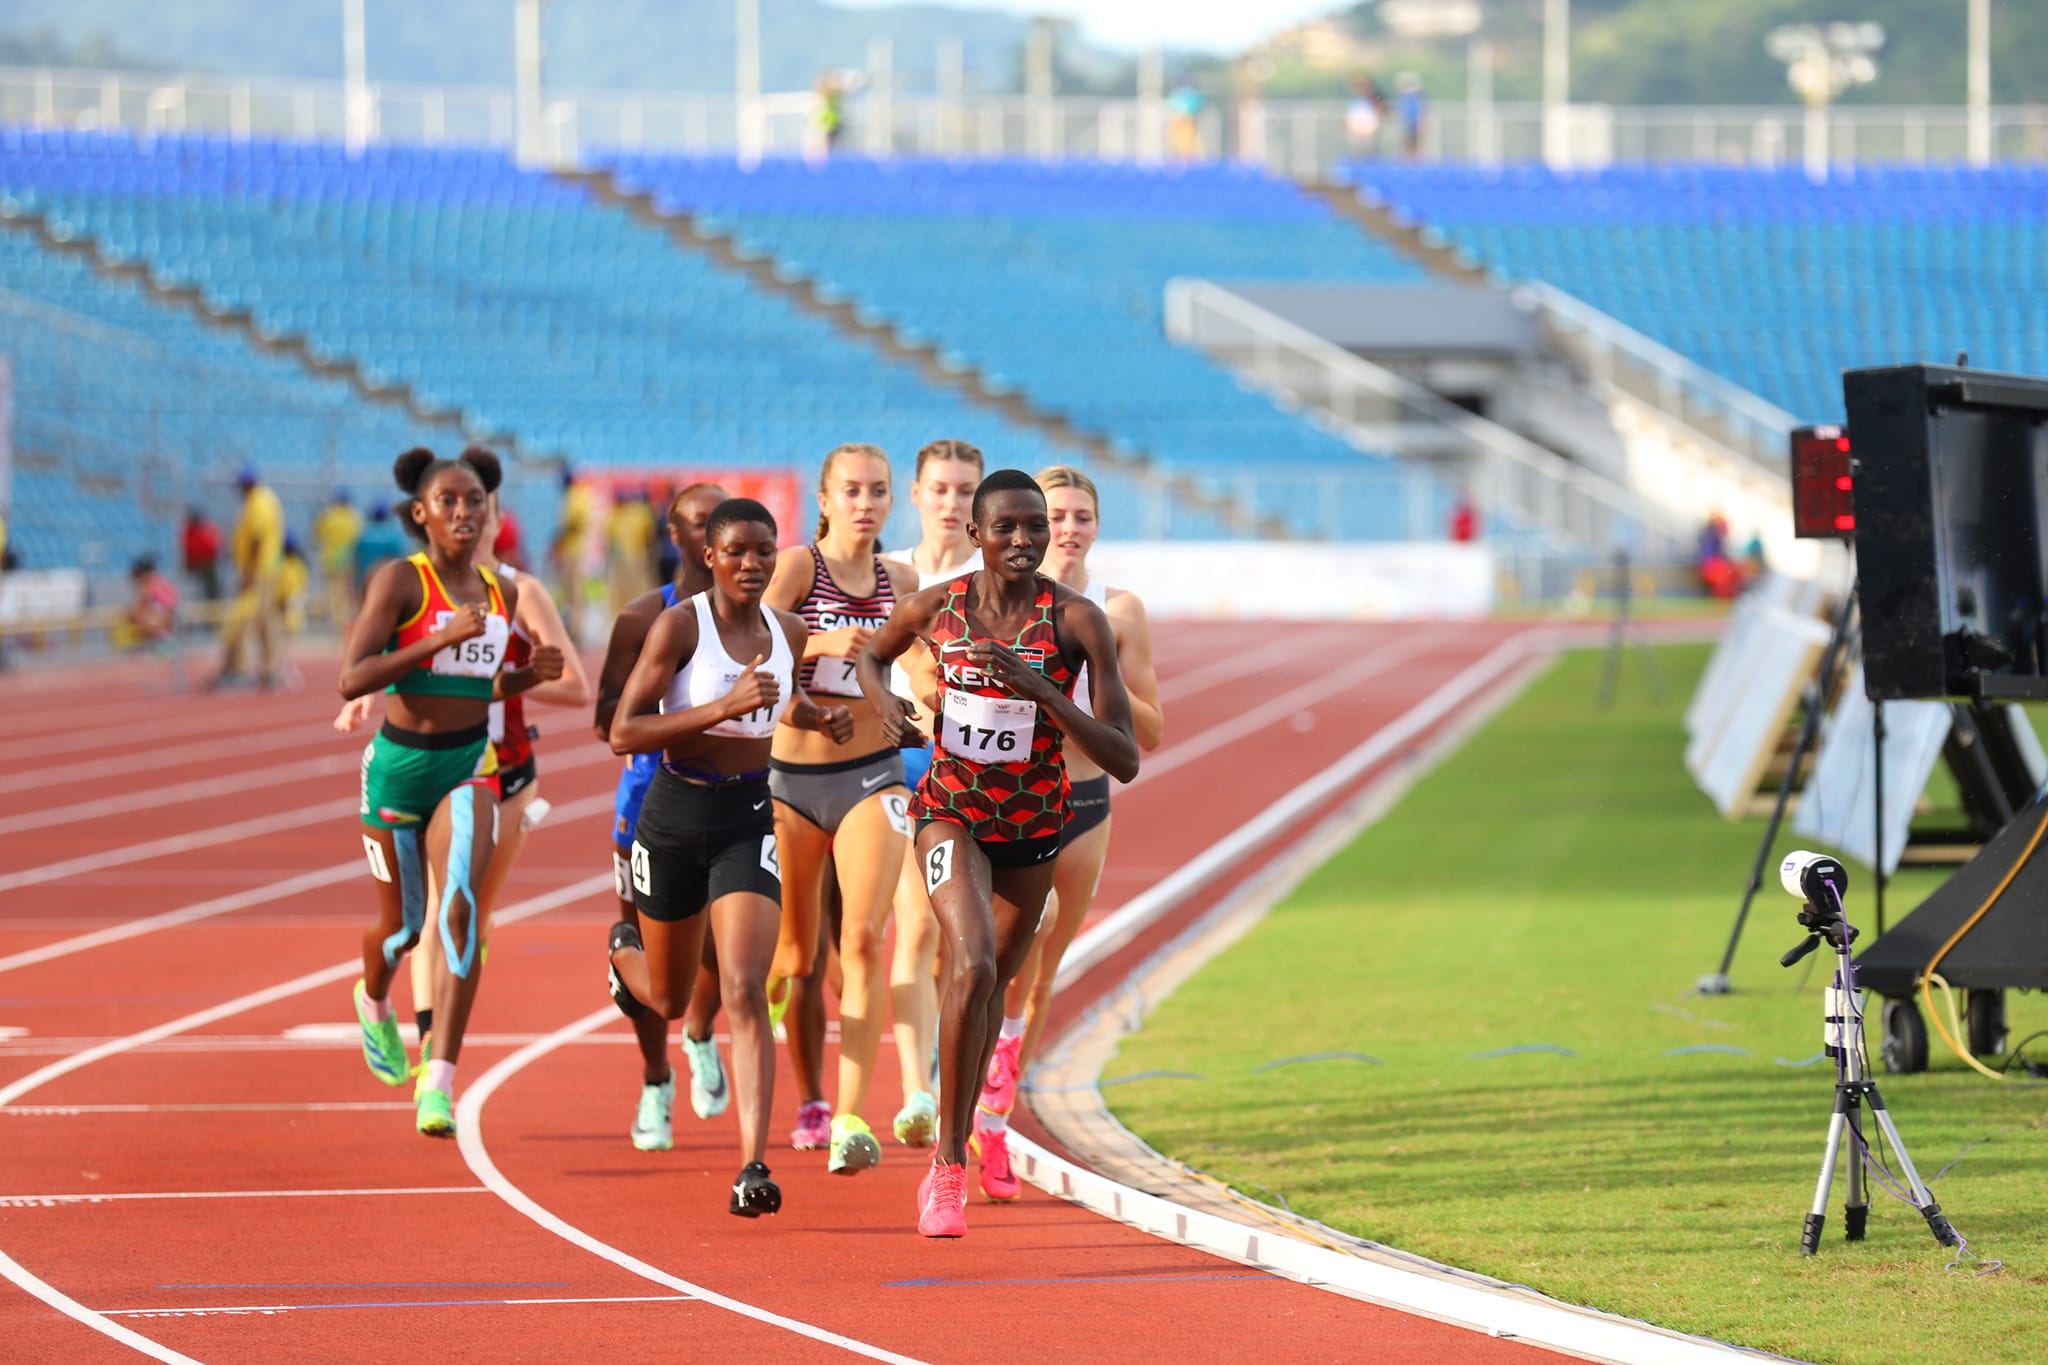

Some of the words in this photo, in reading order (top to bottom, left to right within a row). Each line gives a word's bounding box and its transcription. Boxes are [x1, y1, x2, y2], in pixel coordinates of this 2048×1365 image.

[450, 643, 495, 664] 155
[842, 660, 858, 681] 7
[943, 663, 1006, 689] KEN
[958, 723, 1017, 752] 176
[890, 798, 908, 831] 9
[634, 850, 646, 888] 4
[931, 846, 946, 886] 8
